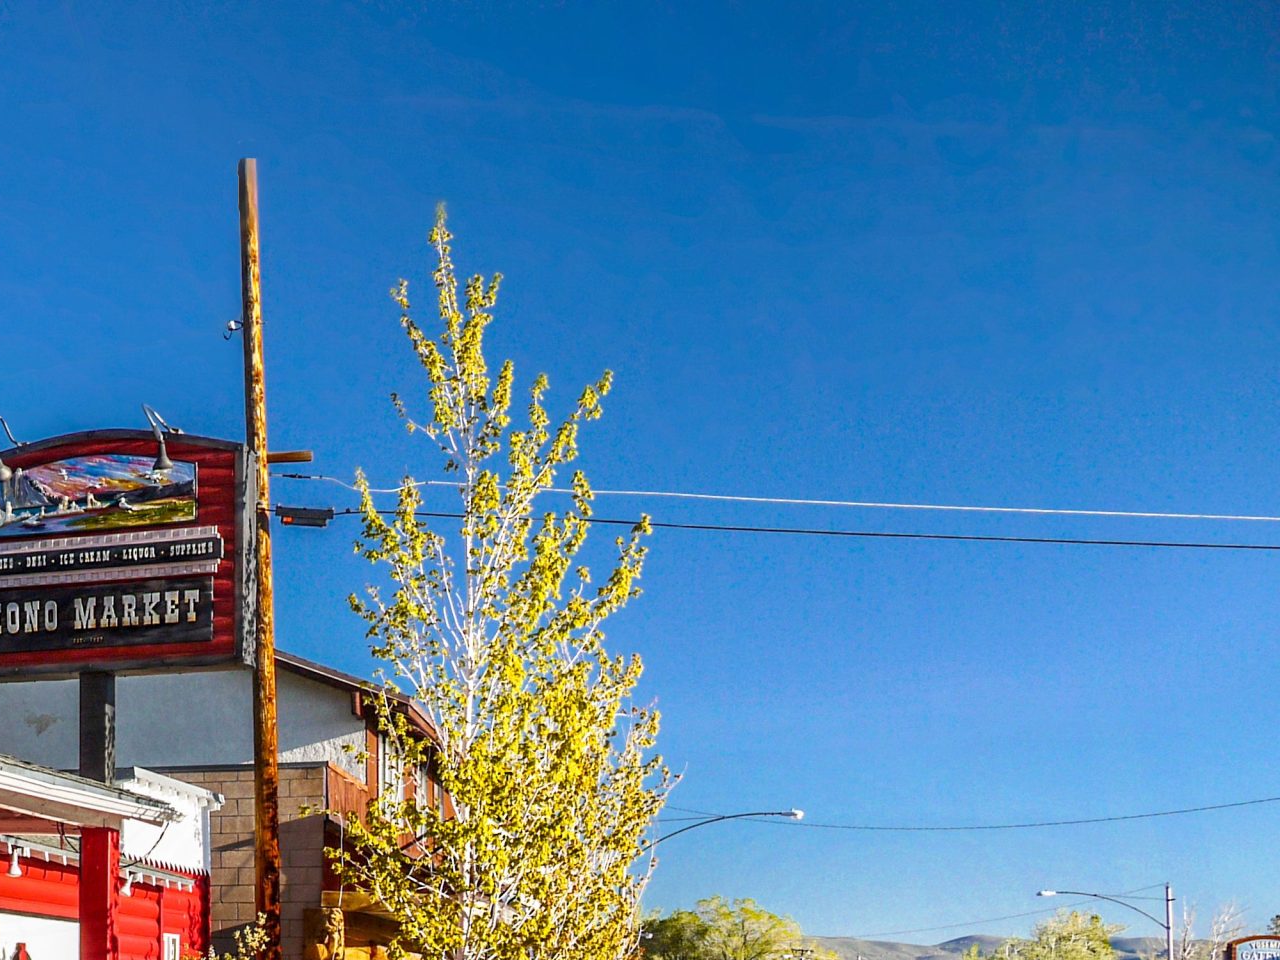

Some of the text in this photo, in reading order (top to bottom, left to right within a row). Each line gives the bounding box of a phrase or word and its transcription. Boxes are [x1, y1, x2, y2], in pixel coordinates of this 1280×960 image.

[26, 555, 47, 568] DELI
[59, 553, 75, 565] ICE
[79, 550, 111, 563] CREAM
[122, 546, 156, 560] LIQUOR
[169, 541, 214, 557] SUPPLIES
[73, 589, 200, 630] MARKET
